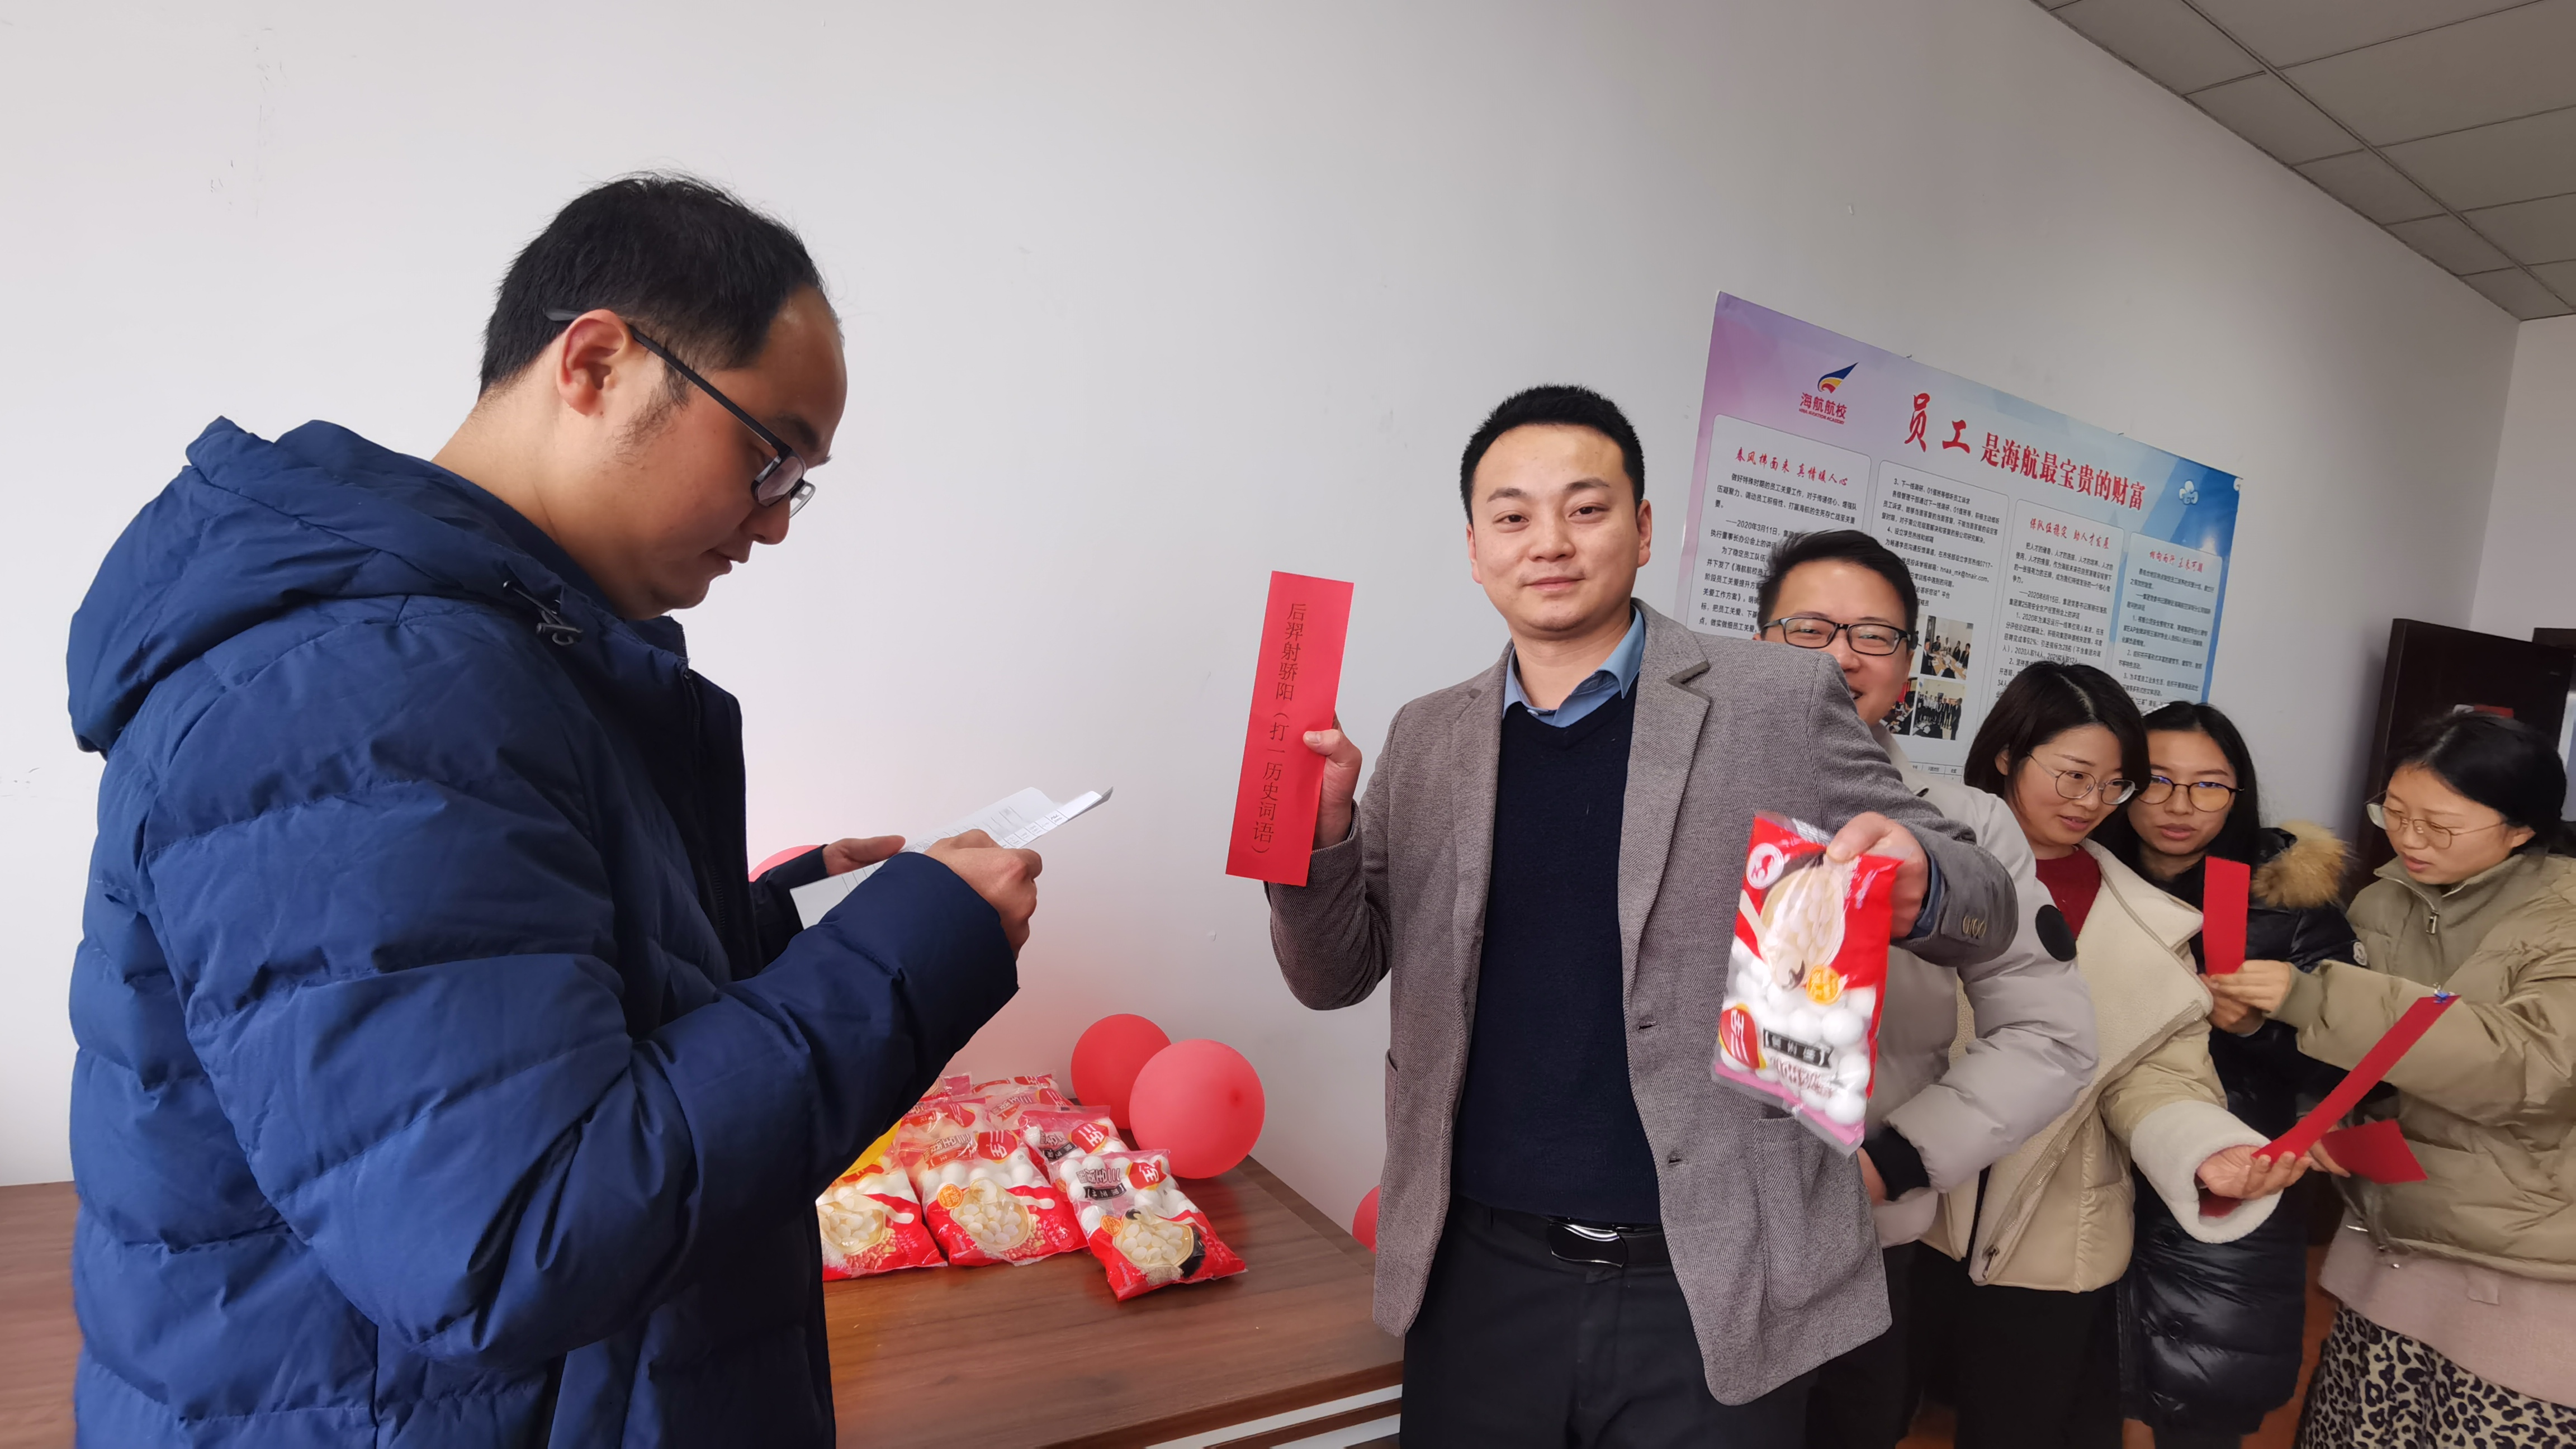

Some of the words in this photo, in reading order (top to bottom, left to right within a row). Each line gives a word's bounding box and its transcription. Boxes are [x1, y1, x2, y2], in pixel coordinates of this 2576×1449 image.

[1800, 392, 1847, 419] 海航航校
[1735, 447, 1789, 473] 春风拂面来
[1797, 463, 1848, 486] 真情暖人心
[1981, 431, 2147, 512] 是海航最宝贵的财富
[1715, 499, 1723, 509] 要。
[2073, 530, 2110, 549] 助人才发展
[989, 1129, 1008, 1158] 三全
